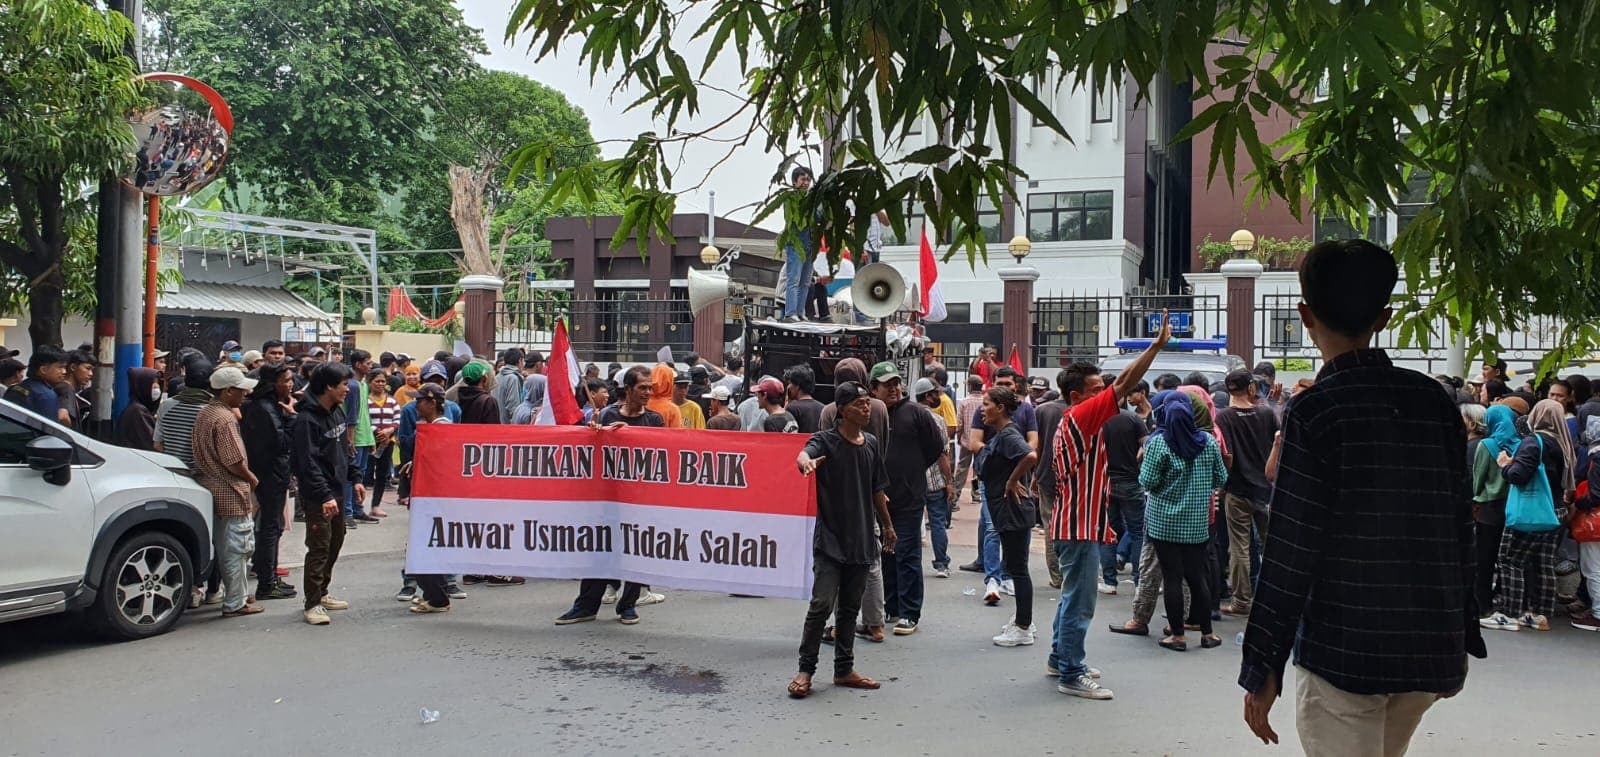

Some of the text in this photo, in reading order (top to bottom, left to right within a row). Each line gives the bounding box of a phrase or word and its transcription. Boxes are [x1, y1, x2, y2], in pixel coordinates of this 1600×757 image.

[463, 444, 746, 487] PULIHKAN NAMA BAIK
[428, 517, 776, 568] Anwar Usman Tidak Salah
